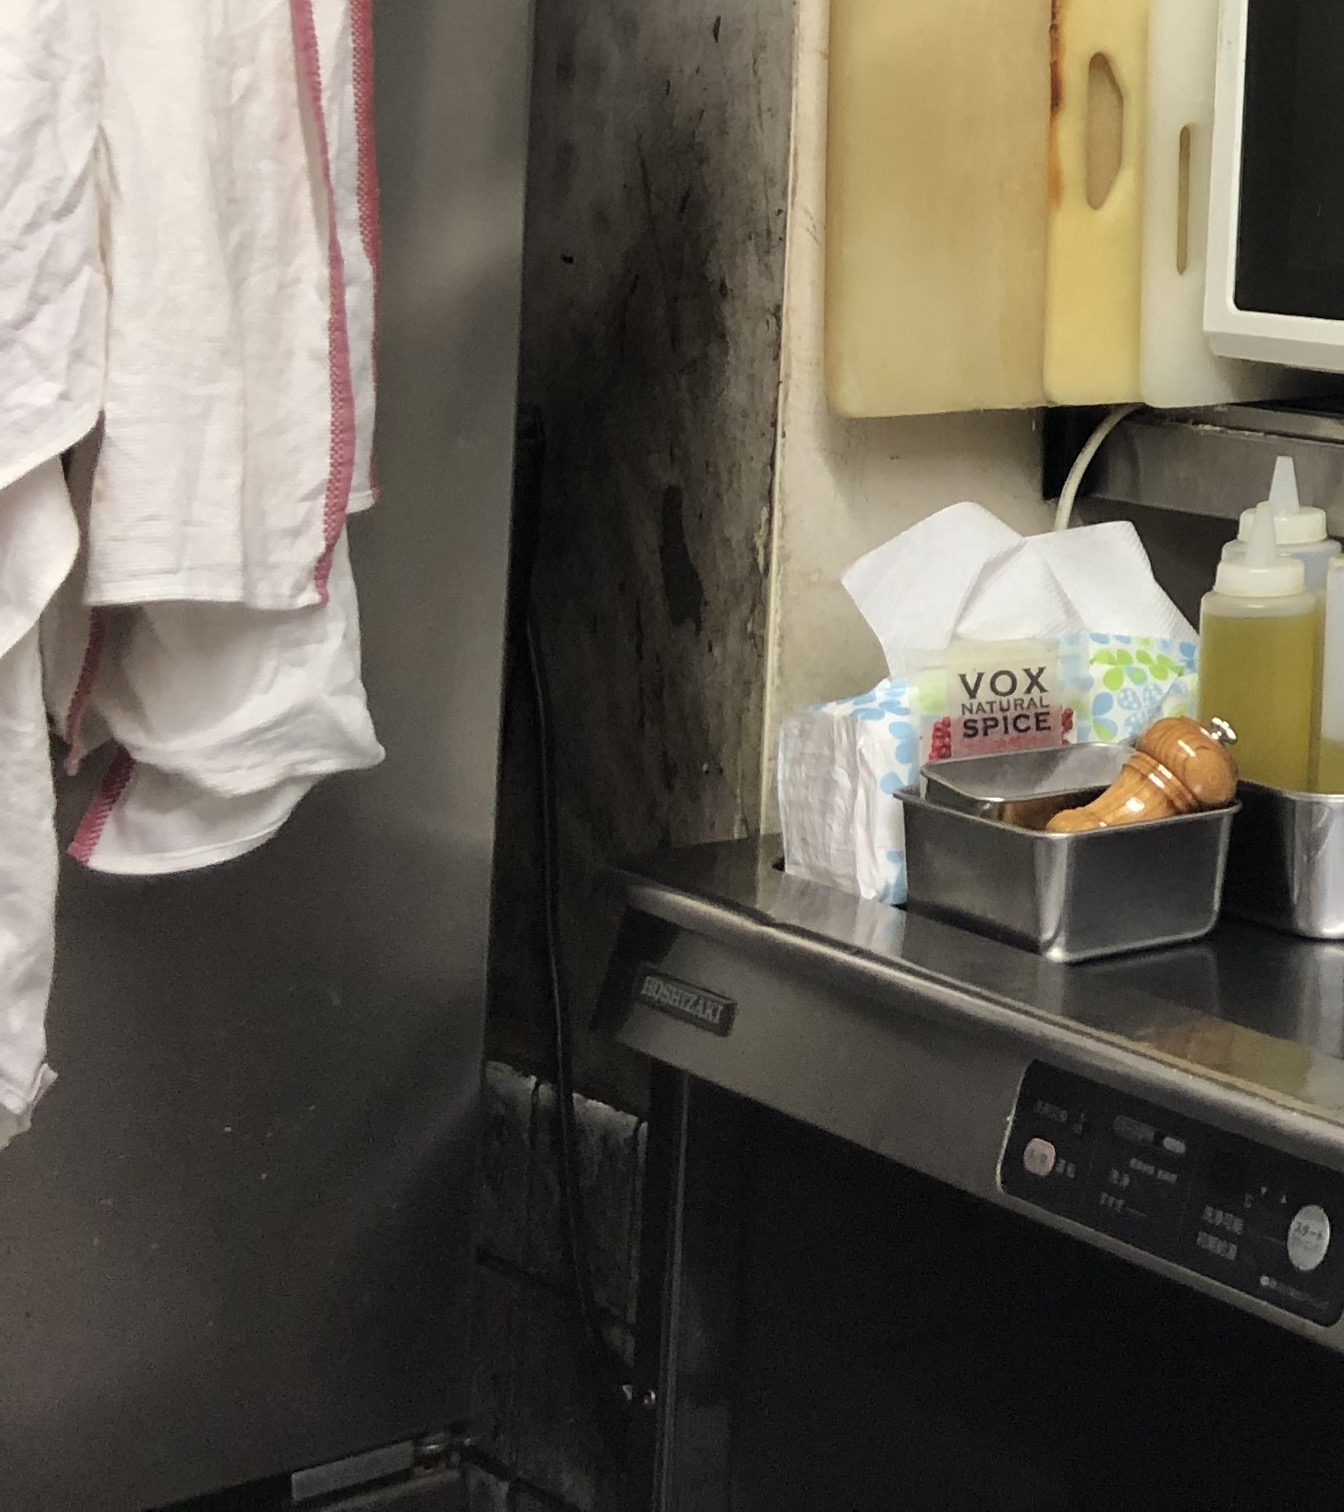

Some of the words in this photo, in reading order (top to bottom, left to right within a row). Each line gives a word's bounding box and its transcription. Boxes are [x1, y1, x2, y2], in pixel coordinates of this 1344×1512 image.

[959, 666, 1048, 699] VOX
[961, 695, 1050, 714] NATURAL
[963, 712, 1051, 738] SPICE
[640, 975, 723, 1024] HOSHIZAKI
